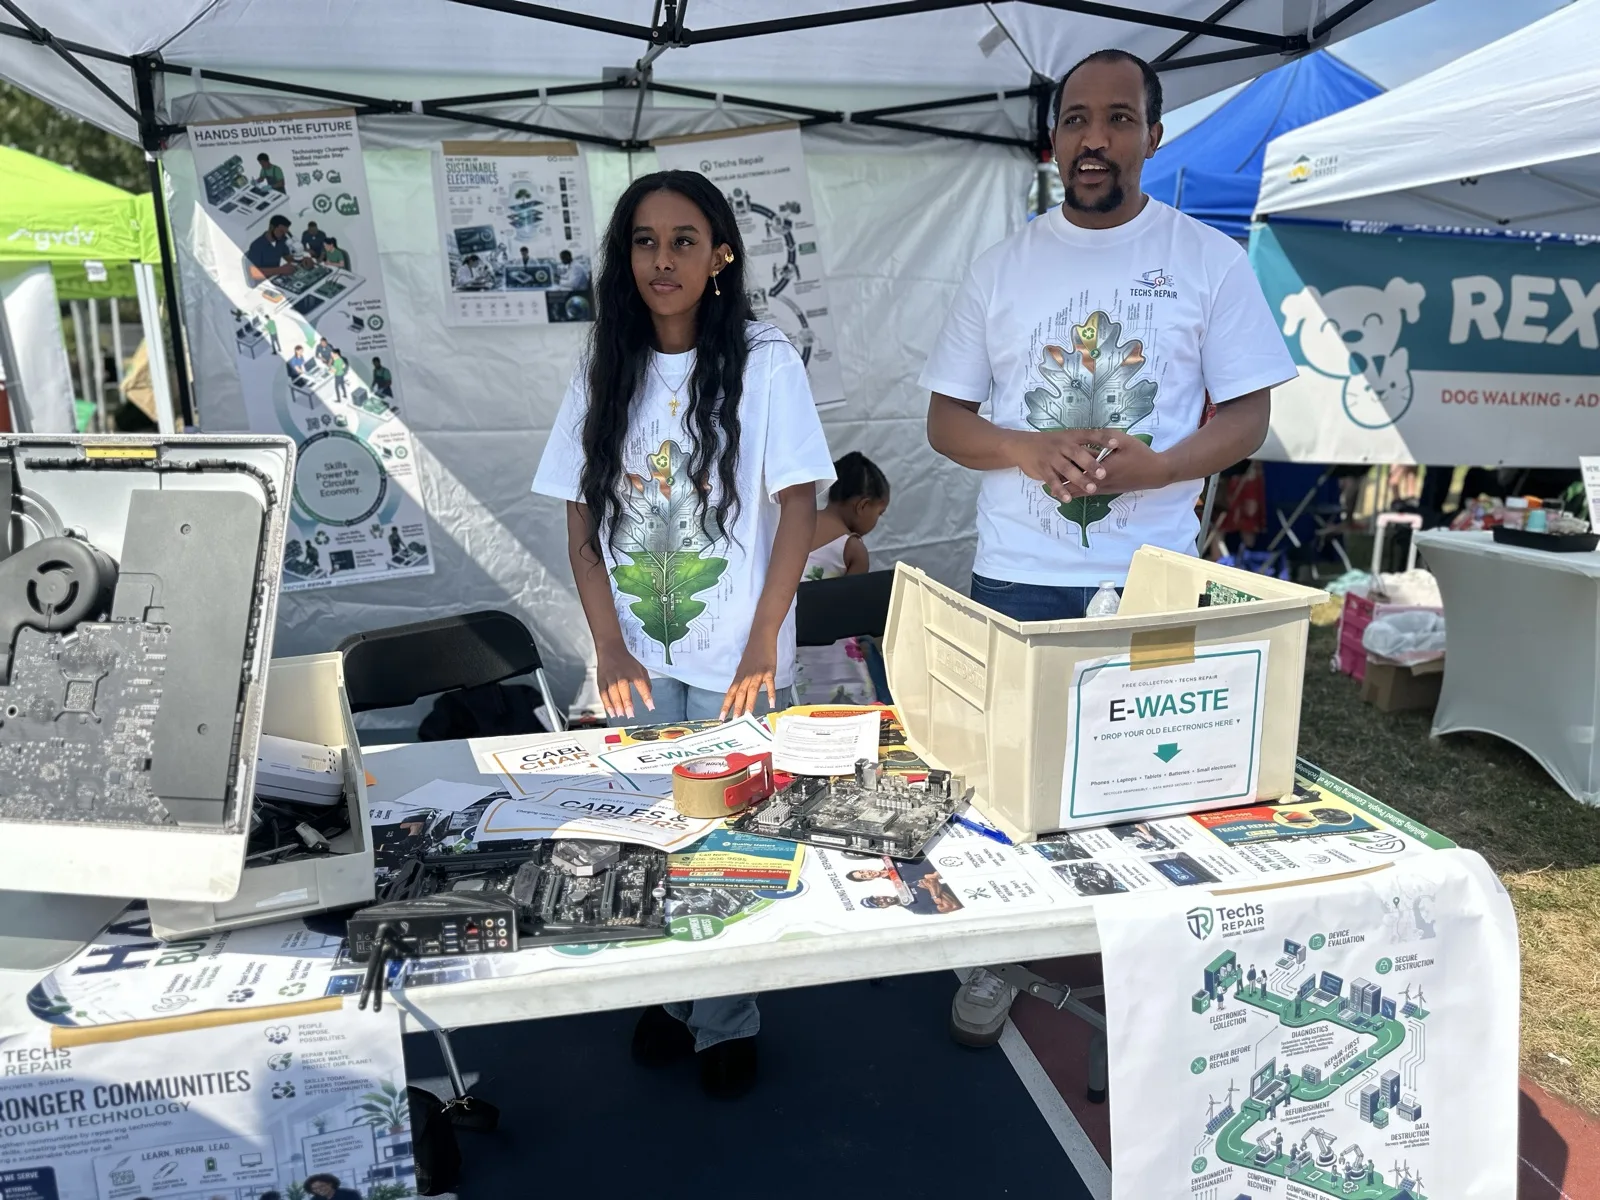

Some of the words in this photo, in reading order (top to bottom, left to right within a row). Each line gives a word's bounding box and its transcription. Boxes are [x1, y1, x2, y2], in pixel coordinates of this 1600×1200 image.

[194, 128, 239, 141] HANDS
[241, 126, 277, 138] BUILD
[279, 123, 304, 136] THE
[306, 120, 353, 133] FUTURE
[446, 162, 497, 173] SUSTAINABLE
[447, 173, 499, 185] ELECTRONICS
[1130, 288, 1152, 296] TECHS
[1154, 290, 1178, 300] REPAIR
[1450, 274, 1600, 349] REX
[1442, 389, 1478, 405] DOG
[1482, 391, 1560, 406] WALKING
[324, 461, 348, 471] Skills
[316, 471, 343, 480] Power
[344, 469, 359, 477] the
[322, 478, 356, 488] Circular
[320, 487, 362, 497] Economy.
[1138, 679, 1173, 687] COLLECTION
[1110, 688, 1229, 722] E-WASTE
[1101, 732, 1122, 741] DROP
[1124, 729, 1144, 738] YOUR
[1146, 727, 1161, 735] OLD
[1162, 721, 1213, 733] ELECTRONICS
[1214, 718, 1233, 727] HERE
[637, 738, 743, 763] E-WASTE
[1116, 776, 1137, 784] Laptops
[1211, 763, 1236, 771] electronics
[1323, 779, 1334, 789] Life
[1341, 788, 1367, 806] Extending
[559, 800, 666, 819] CABLES
[1215, 824, 1249, 833] TECHS
[1250, 822, 1280, 830] REPAIR
[1384, 814, 1405, 828] Skilled
[1403, 824, 1428, 839] Building
[816, 849, 834, 870] REPAIRING
[1236, 850, 1269, 872] PRACTICAL
[1244, 845, 1275, 863] MATTER
[1265, 849, 1301, 868] SKILLED
[827, 872, 844, 890] PEOPLE.
[988, 880, 1010, 902] ELECTRONICS
[1000, 885, 1014, 896] REPAIR
[836, 890, 855, 911] BUILDING
[1216, 903, 1264, 921] Techs
[1222, 917, 1264, 932] REPAIR
[1328, 929, 1350, 939] DEVICE
[1328, 935, 1365, 947] EVALUATION
[208, 941, 226, 960] SKILLED
[1395, 954, 1418, 963] SECURE
[1395, 959, 1434, 971] DESTRUCTION
[1210, 1009, 1247, 1023] ELECTRONICS
[1213, 1017, 1247, 1030] COLLECTION
[1292, 1025, 1329, 1038] DIAGNOSTICS
[4, 1047, 71, 1063] TECHS
[1209, 1050, 1229, 1062] REPAIR
[1230, 1045, 1251, 1056] BEFORE
[1324, 1036, 1359, 1068] REPAIR-FIRST
[1333, 1047, 1358, 1070] SERVICES
[4, 1058, 72, 1076] REPAIR
[302, 1062, 330, 1070] PROTECT
[1209, 1056, 1240, 1070] RECYCLING
[94, 1070, 252, 1109] COMMUNITIES
[65, 1101, 191, 1129] TECHNOLOGY
[1285, 1101, 1330, 1116] REFURBISHMENT
[80, 1131, 89, 1139] by
[92, 1126, 126, 1138] repairing
[1391, 1130, 1430, 1141] DESTRUCTION
[19, 1152, 62, 1162] sustainable
[65, 1147, 88, 1155] future
[24, 1144, 56, 1154] creating
[142, 1150, 171, 1161] LEARN.
[175, 1146, 206, 1156] REPAIR.
[209, 1142, 232, 1151] LEAD.
[3, 1173, 15, 1181] WE
[17, 1171, 39, 1180] SERVE
[1191, 1166, 1233, 1185] ENVIRONMENTAL
[1191, 1173, 1232, 1192] SUSTAINABILITY
[1248, 1172, 1276, 1186] COMPONENT
[1248, 1180, 1272, 1192] RECOVERY
[1287, 1184, 1319, 1200] COMPONENT
